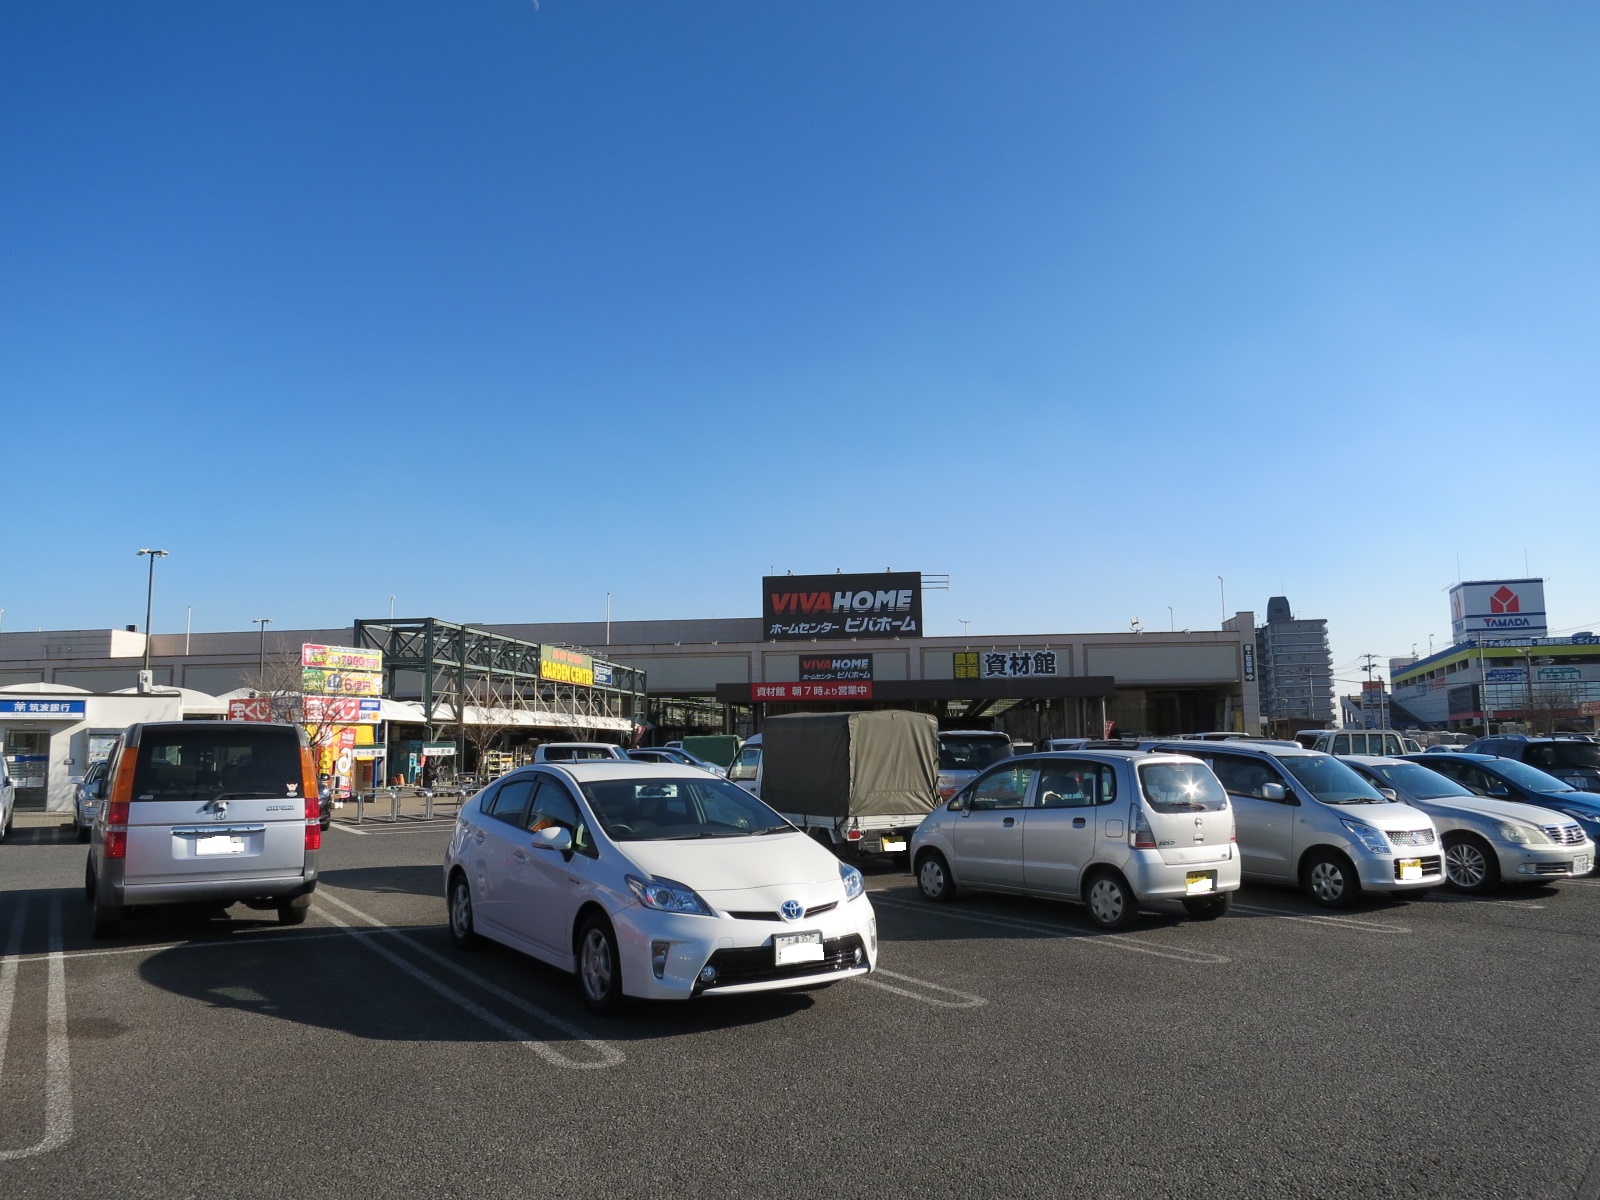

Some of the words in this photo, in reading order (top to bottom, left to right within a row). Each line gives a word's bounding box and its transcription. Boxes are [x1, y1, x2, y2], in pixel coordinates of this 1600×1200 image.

[771, 589, 913, 614] VIVAHOME
[769, 621, 840, 635] ホームセンター
[845, 616, 917, 632] ビバホーム
[1483, 618, 1530, 627] YAMADA
[541, 660, 571, 682] GARDEN
[571, 666, 593, 686] CENTER
[802, 658, 870, 671] VIVAHOME
[984, 650, 1057, 677] 資材館
[836, 671, 871, 679] ビバホーム
[756, 686, 786, 697] 資材館
[29, 703, 71, 712] 筑波銀行
[231, 702, 270, 721] 宝くじ
[305, 699, 356, 721] 宝くじ
